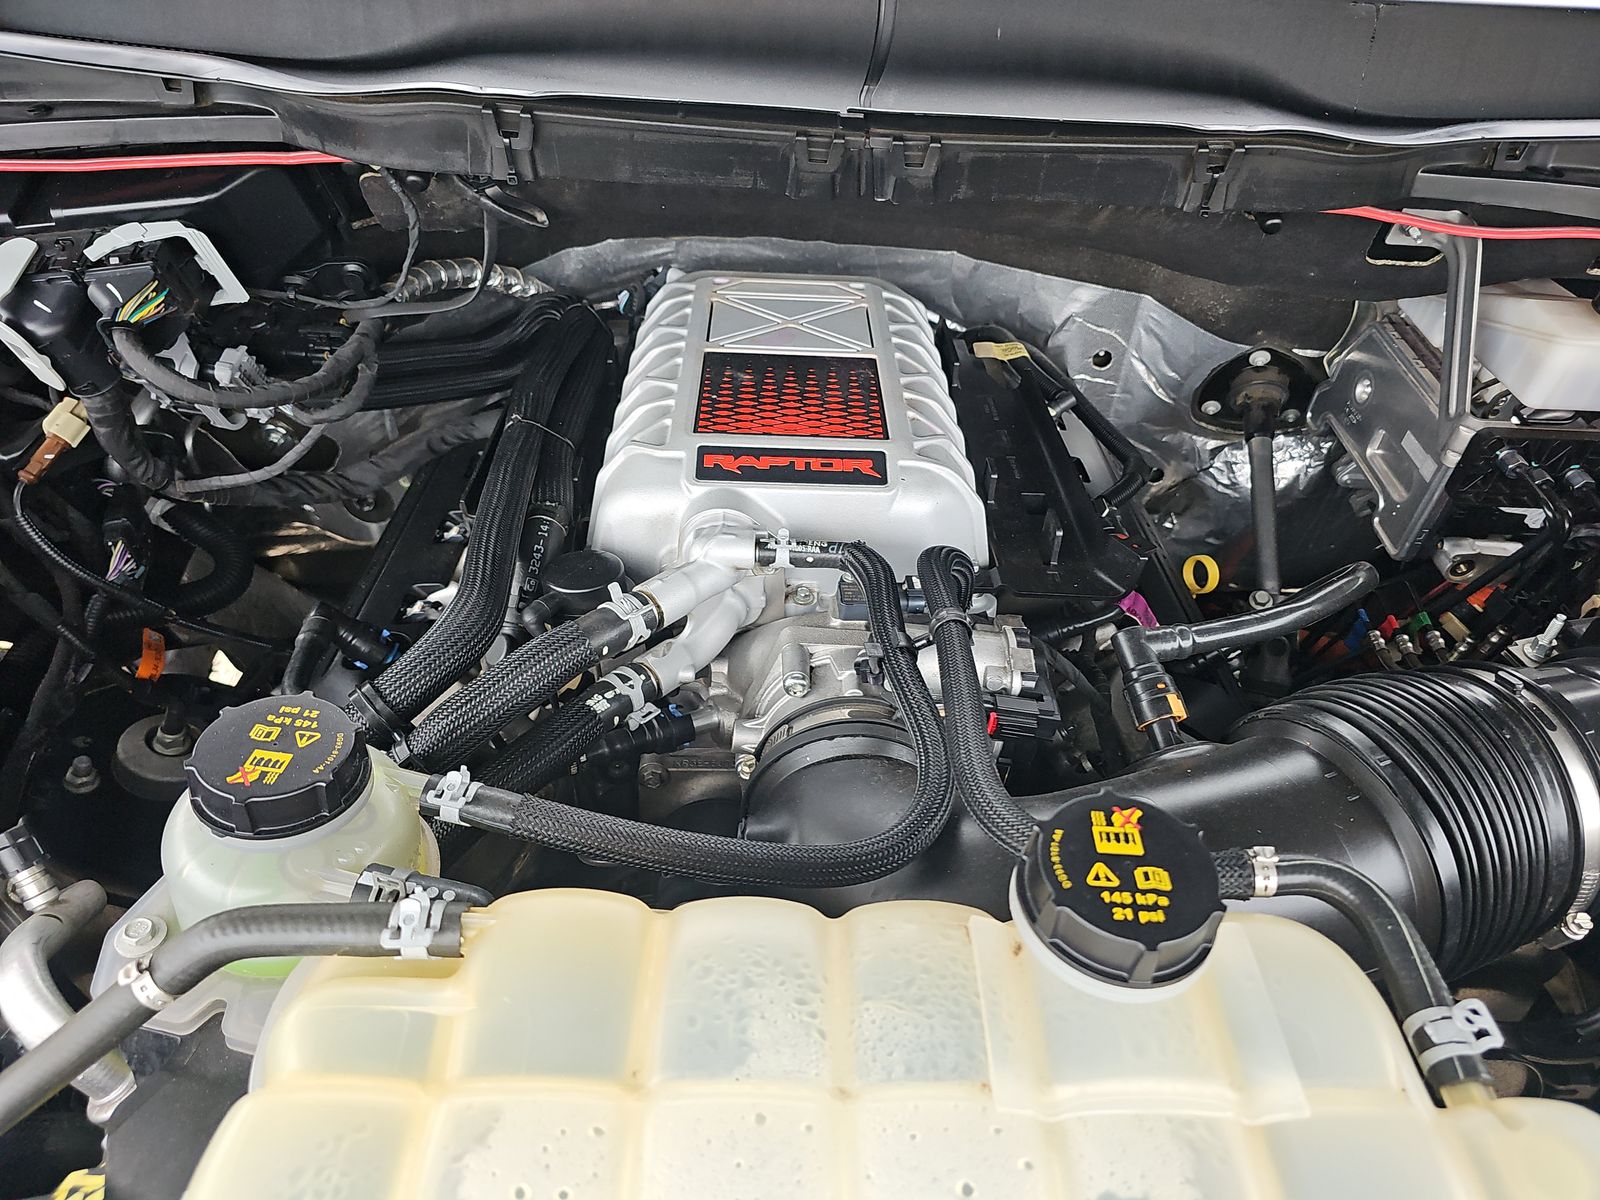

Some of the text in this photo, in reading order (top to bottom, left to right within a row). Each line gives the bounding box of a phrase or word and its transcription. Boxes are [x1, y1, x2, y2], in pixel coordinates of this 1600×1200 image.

[703, 454, 882, 478] RAPTOR
[279, 705, 320, 719] 21 psi
[266, 714, 319, 729] 145 kPa
[1100, 890, 1171, 907] 145 kPa
[1111, 907, 1135, 921] 21
